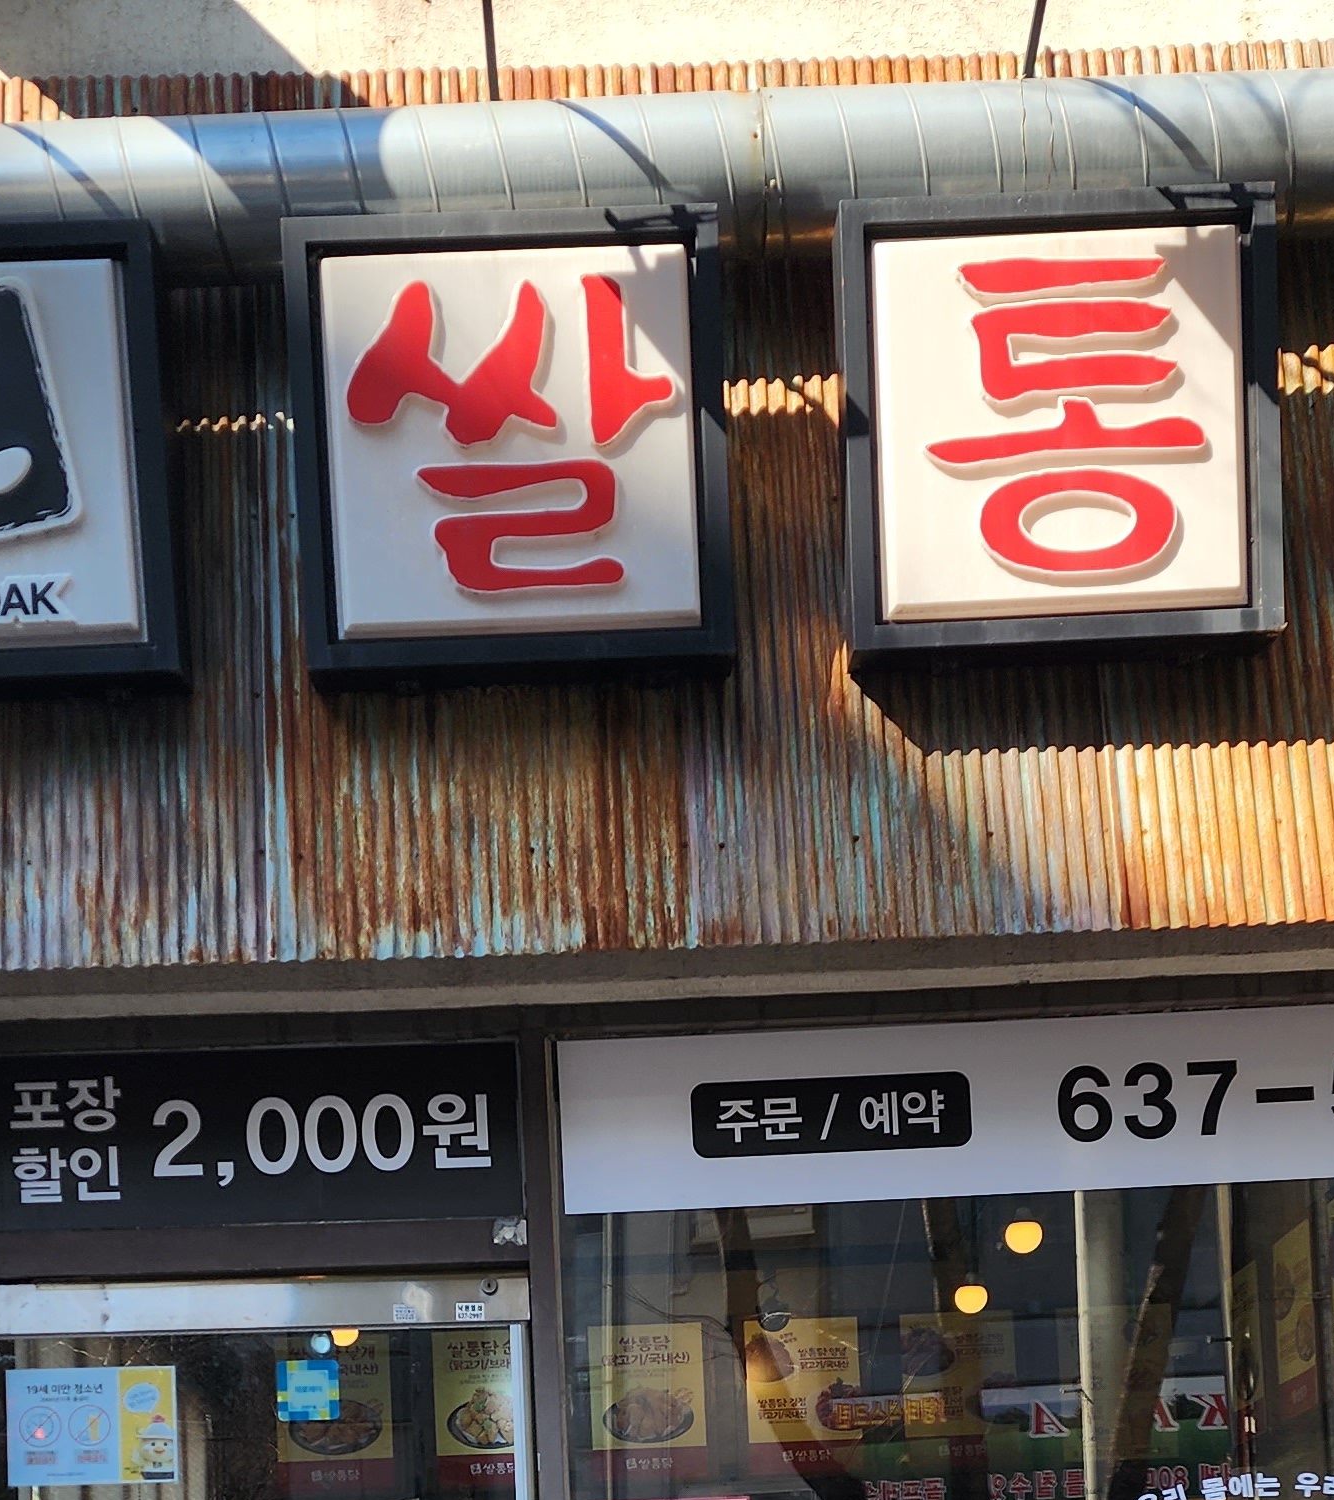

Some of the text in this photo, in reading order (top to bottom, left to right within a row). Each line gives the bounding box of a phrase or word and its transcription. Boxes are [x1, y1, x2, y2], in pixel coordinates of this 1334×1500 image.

[10, 1076, 122, 1134] 포장
[715, 1097, 803, 1144] 주문
[859, 1087, 946, 1136] 예약
[153, 1092, 493, 1188] 2,000원
[11, 1145, 122, 1205] 할인
